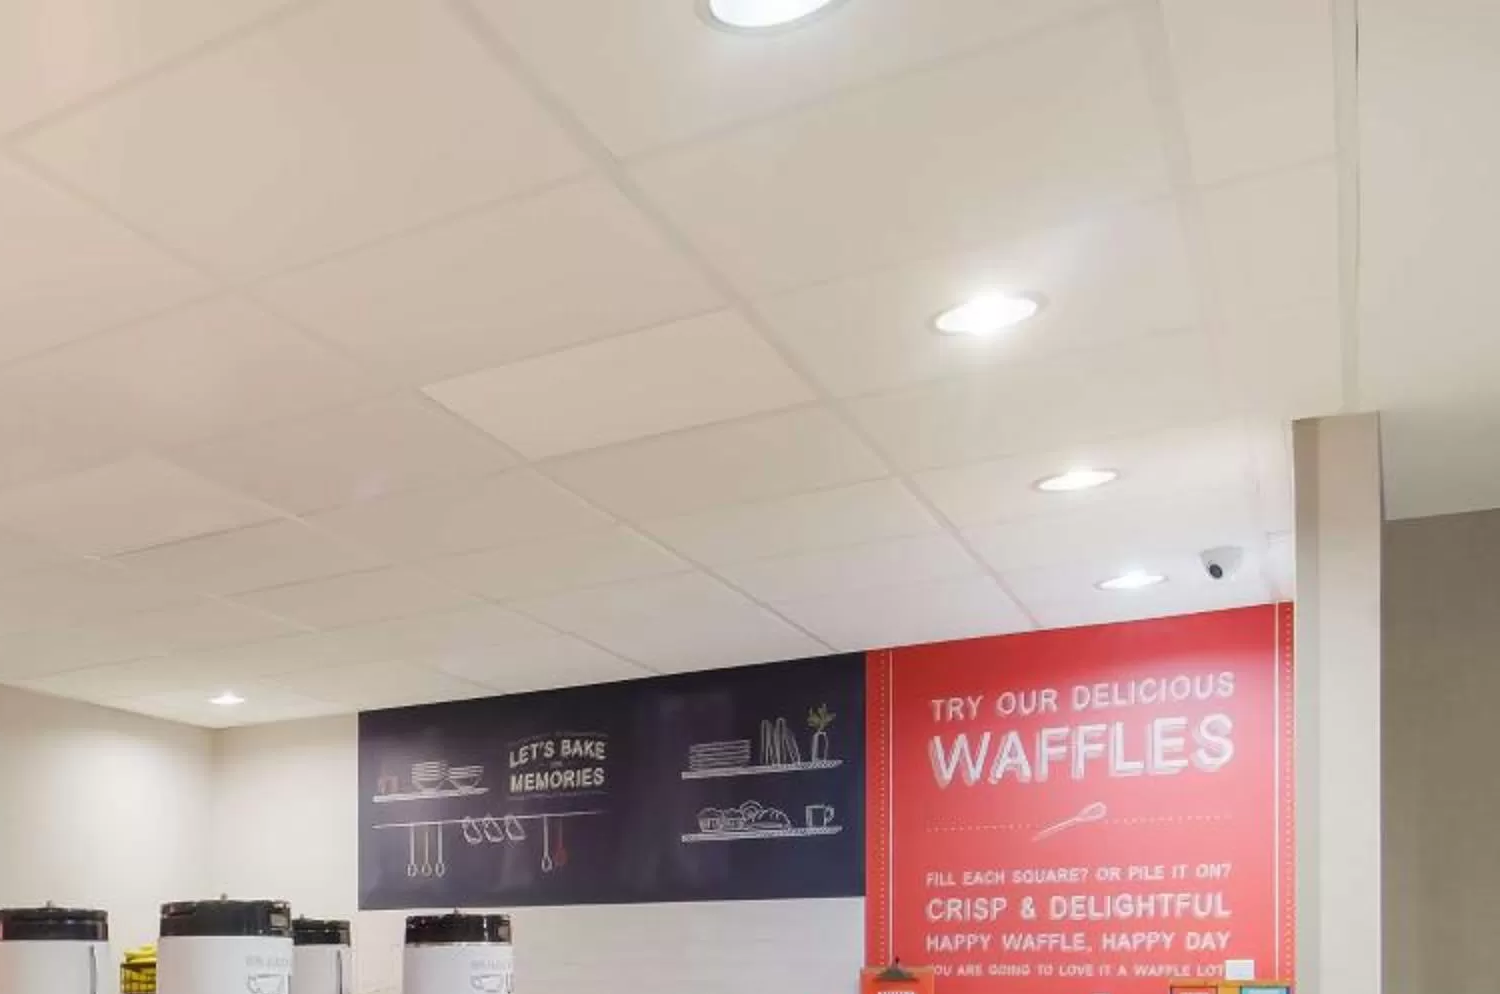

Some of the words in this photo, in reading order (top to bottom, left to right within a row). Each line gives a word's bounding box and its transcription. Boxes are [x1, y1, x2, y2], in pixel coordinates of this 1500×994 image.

[930, 695, 984, 722] TRY
[997, 688, 1058, 716] OUR
[1072, 671, 1235, 711] DELICIOUS
[509, 740, 555, 768] LET'S
[561, 739, 607, 760] BAKE
[928, 714, 1235, 789] WAFFLES
[510, 767, 605, 793] MEMORIES
[925, 871, 956, 888] FILL
[962, 869, 1006, 887] EACH
[1012, 867, 1089, 885] SQUARE?
[1095, 867, 1122, 881] OR
[1128, 865, 1165, 881] PILE
[1171, 863, 1189, 880] IT
[1196, 862, 1233, 880] ON?
[925, 896, 1008, 922] CRISP
[1020, 895, 1037, 920] &
[1049, 891, 1233, 921] DELIGHTFUL
[925, 932, 992, 952] HAPPY
[1101, 931, 1175, 952] HAPPY
[1185, 930, 1232, 951] DAY
[933, 964, 953, 976] OU
[956, 963, 983, 976] ARE
[988, 963, 1031, 976] GOING
[1037, 963, 1053, 976] TO
[1058, 963, 1094, 976] LOVE
[1116, 964, 1128, 976] A
[1134, 963, 1191, 977] WAFFLE
